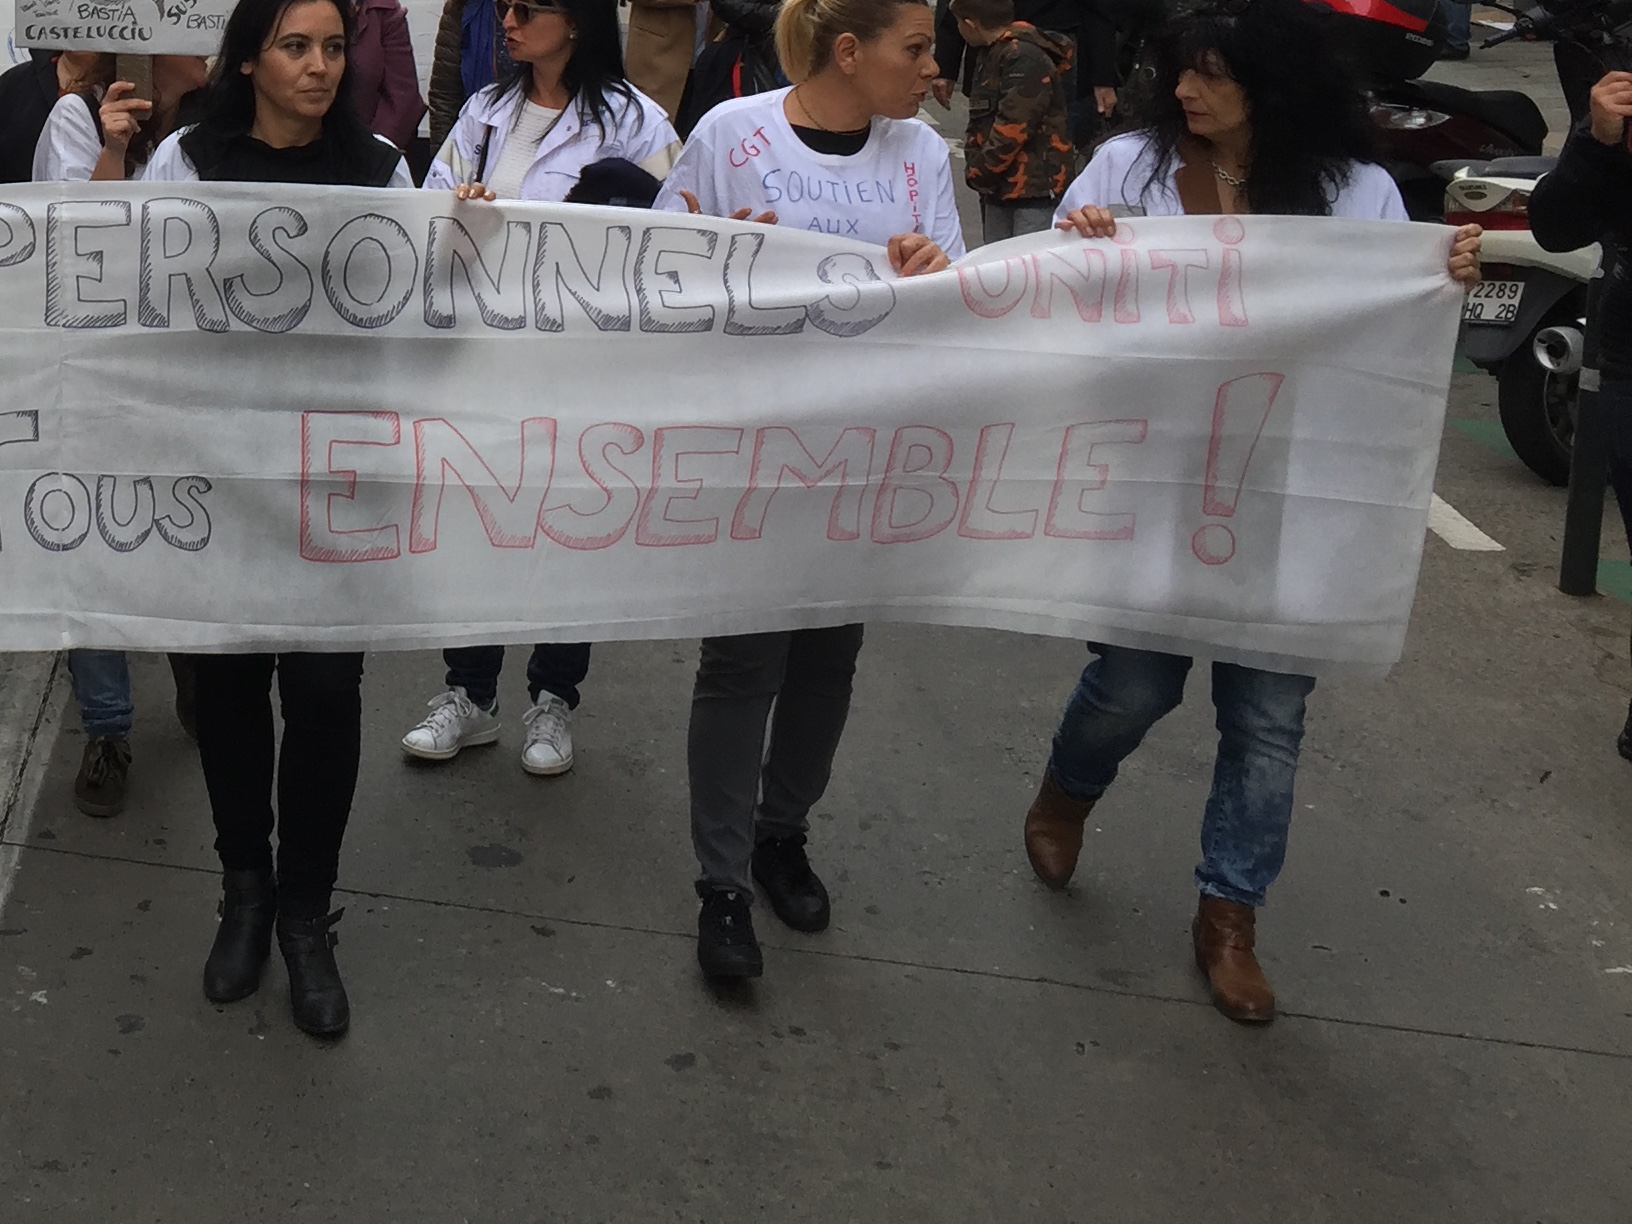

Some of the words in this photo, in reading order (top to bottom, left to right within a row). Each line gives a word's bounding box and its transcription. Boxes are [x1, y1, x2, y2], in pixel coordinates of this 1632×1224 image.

[186, 9, 229, 30] BASTI
[729, 126, 772, 168] CGT
[807, 216, 860, 235] AUX
[1473, 282, 1518, 299] 2289
[1464, 302, 1484, 319] HQ
[1495, 303, 1517, 319] 2B
[299, 410, 1149, 563] ENSEMBLE
